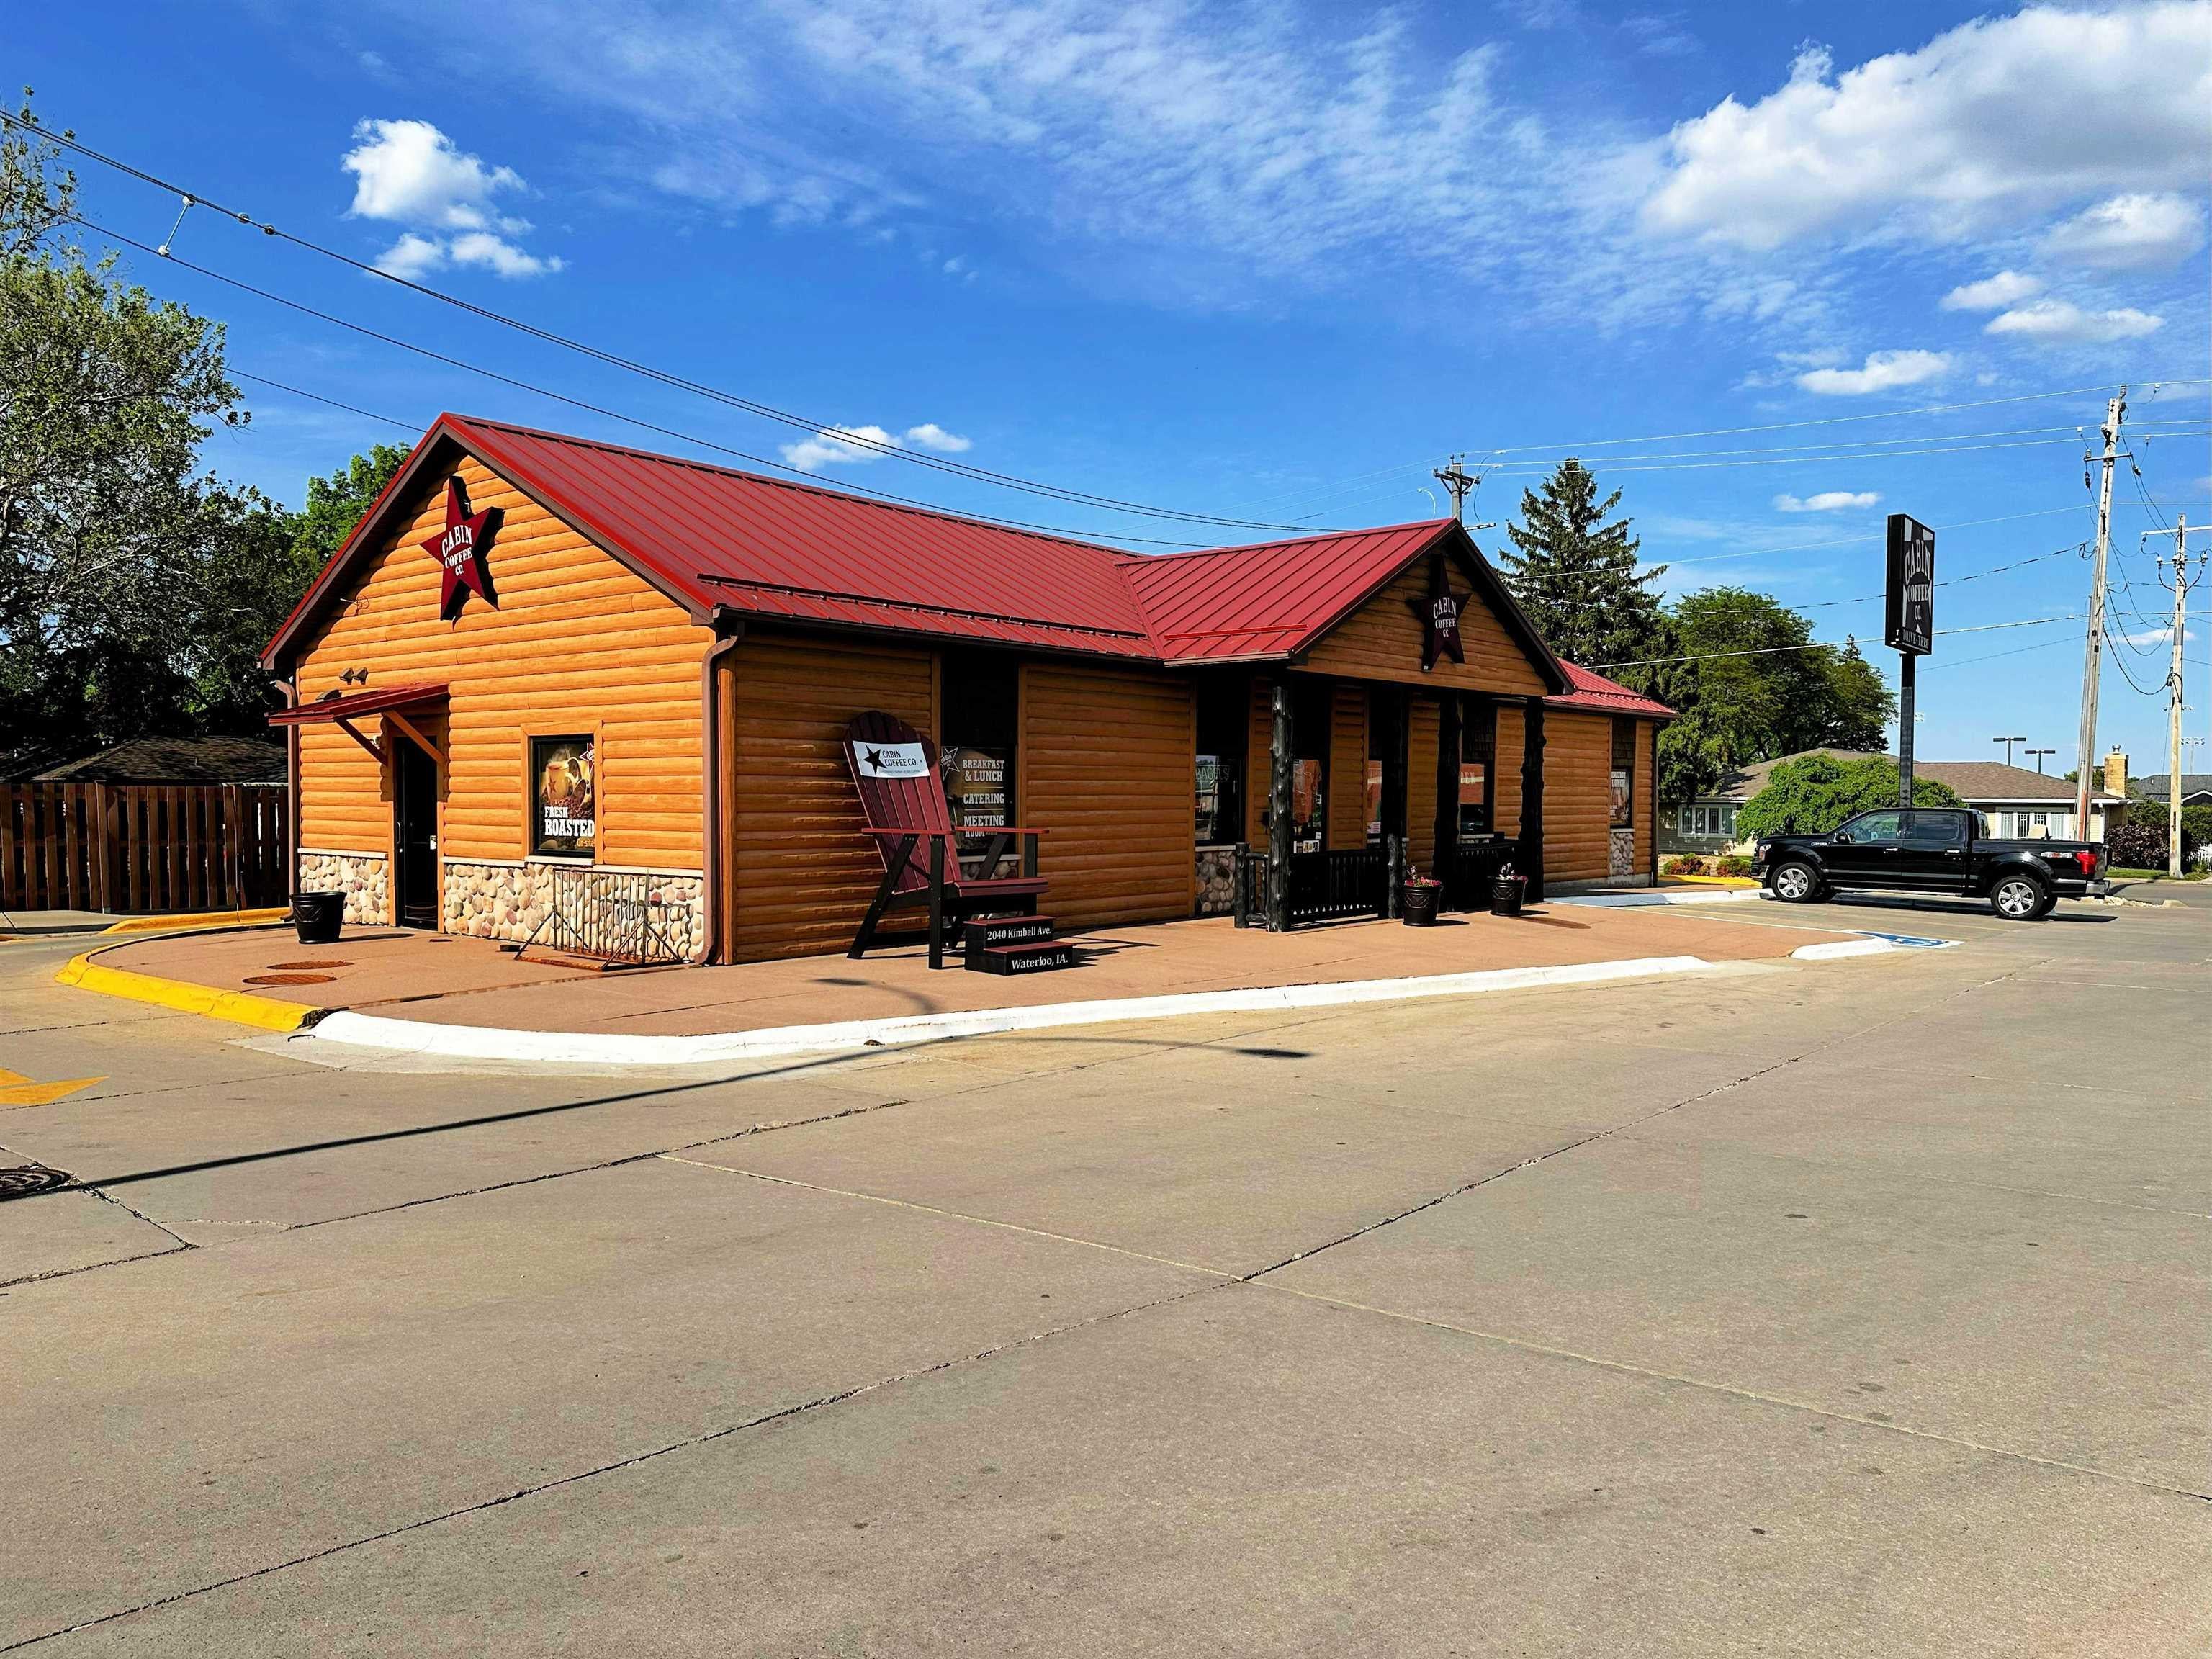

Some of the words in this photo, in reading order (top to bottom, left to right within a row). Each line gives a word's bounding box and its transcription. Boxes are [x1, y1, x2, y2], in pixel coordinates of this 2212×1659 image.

[442, 525, 472, 557] CABIN
[445, 547, 472, 569] COFFEE
[1905, 539, 1930, 585] CABIN
[1907, 584, 1928, 602] COFFEE
[1434, 597, 1456, 619] CABIN
[1435, 618, 1456, 629] COFFEE
[963, 760, 1004, 769] BREAKFAST
[965, 770, 971, 781] &
[974, 770, 1002, 781] LUNCH
[963, 793, 1004, 804] CATERING
[544, 806, 568, 818] FRESH
[963, 815, 1004, 827] MEETING
[544, 819, 595, 837] ROASTED
[987, 930, 1007, 940] 2040
[1008, 926, 1036, 938] Kimball
[1037, 926, 1051, 935] Ave.
[1012, 956, 1054, 969] Waterloo,
